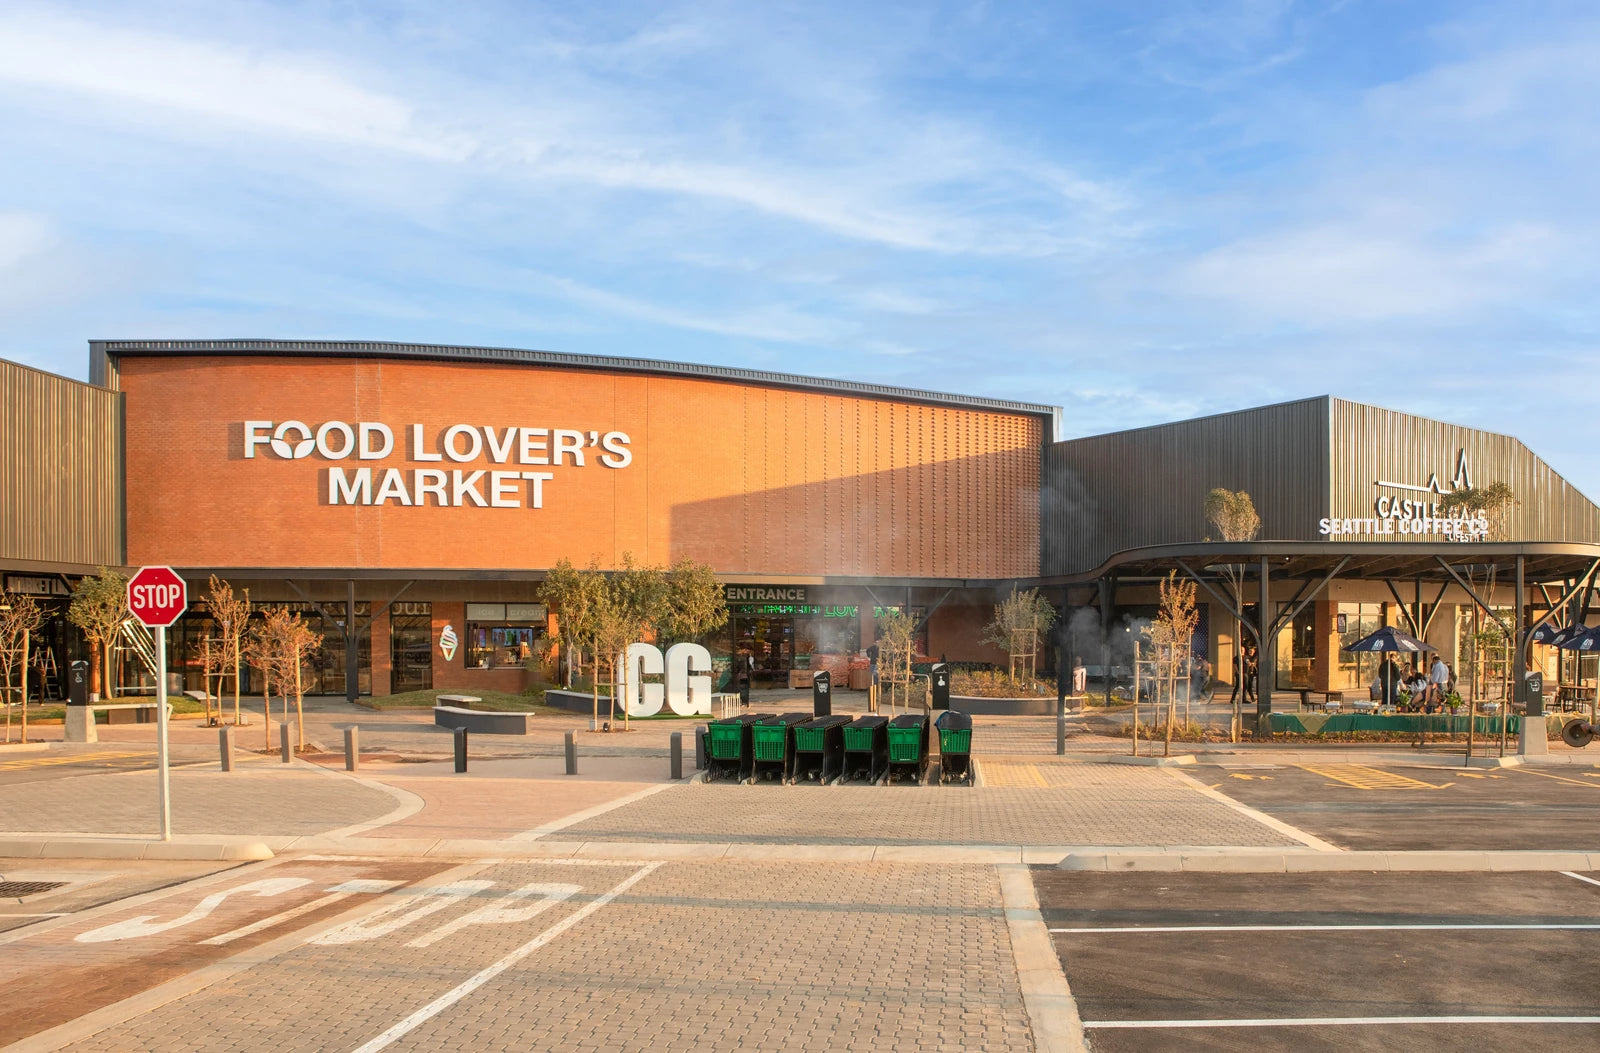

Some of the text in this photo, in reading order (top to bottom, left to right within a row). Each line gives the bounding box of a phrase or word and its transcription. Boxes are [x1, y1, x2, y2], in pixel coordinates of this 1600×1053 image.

[244, 420, 633, 468] FOOD LOVER'S
[328, 467, 553, 508] MARKET
[1319, 518, 1395, 534] SEATTLE
[133, 584, 181, 609] STOP
[727, 587, 805, 600] ENTRANCE
[616, 642, 712, 718] CG
[74, 877, 584, 948] STOP
